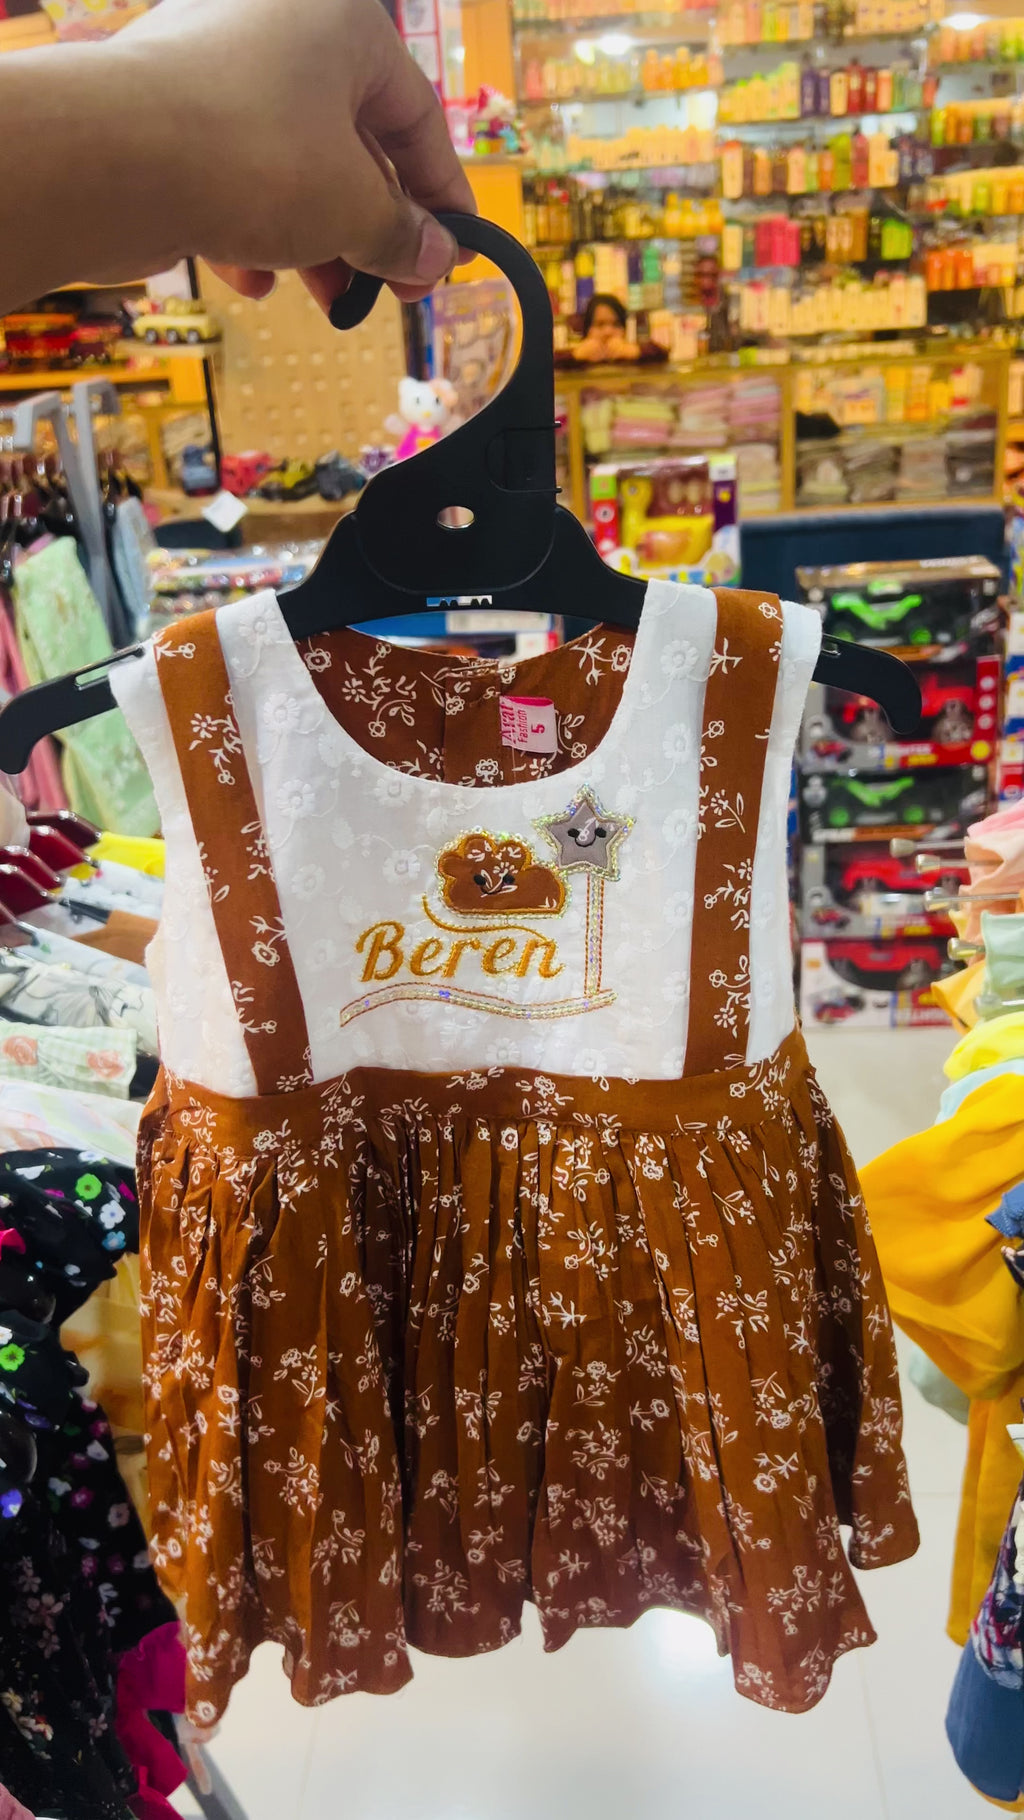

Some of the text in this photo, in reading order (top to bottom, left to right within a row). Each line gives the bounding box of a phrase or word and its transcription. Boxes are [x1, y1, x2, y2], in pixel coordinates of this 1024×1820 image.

[518, 710, 528, 743] Fashion
[531, 724, 545, 734] 5
[355, 920, 565, 982] Beren
